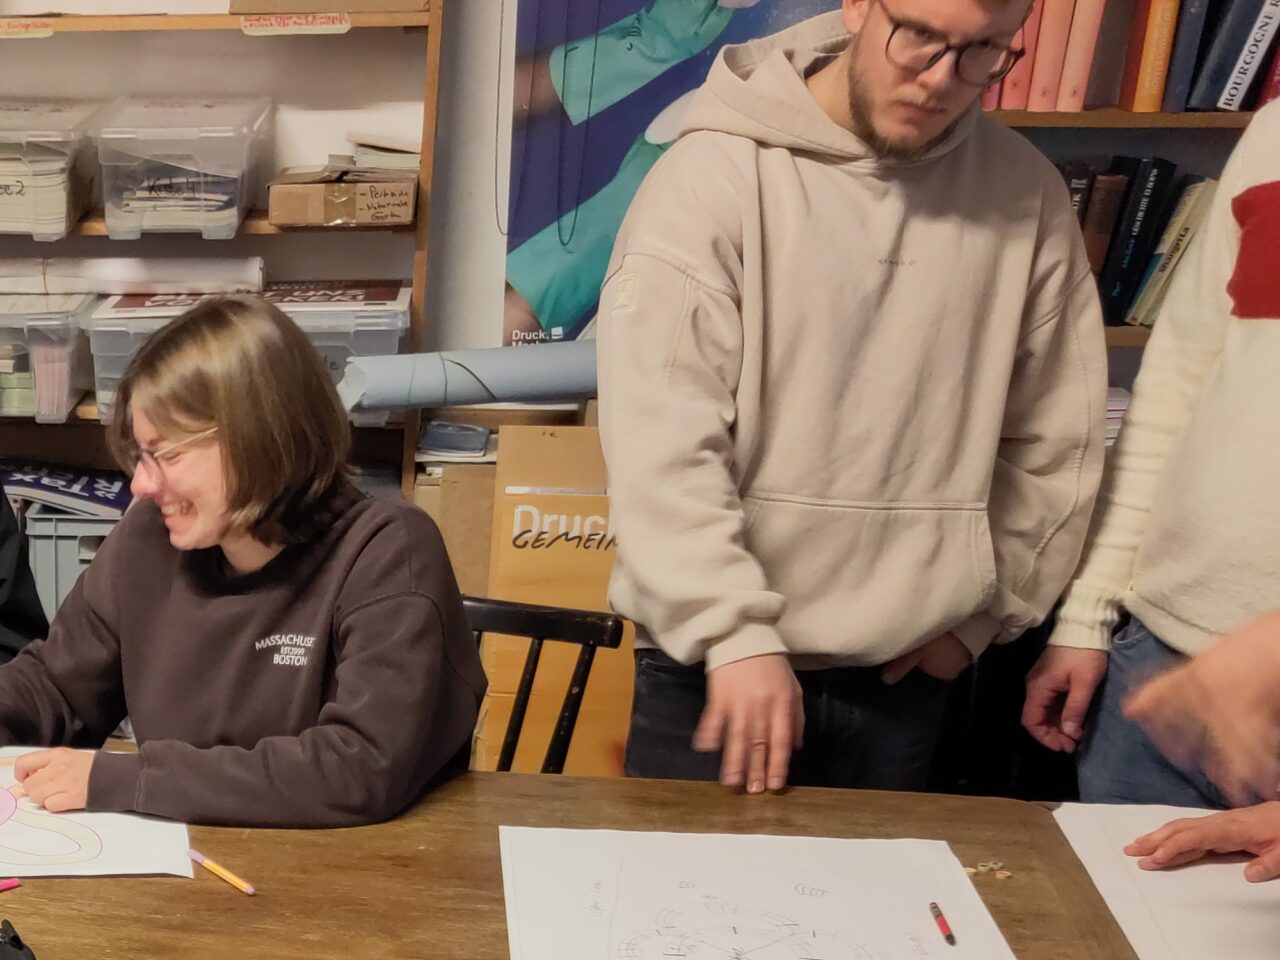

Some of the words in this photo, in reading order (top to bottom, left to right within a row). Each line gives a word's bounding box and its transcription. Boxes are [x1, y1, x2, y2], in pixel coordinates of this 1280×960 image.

[1222, 11, 1274, 107] BOURGOGNE
[15, 180, 26, 197] 2
[512, 329, 550, 340] Druck.
[272, 653, 308, 666] BOSTON
